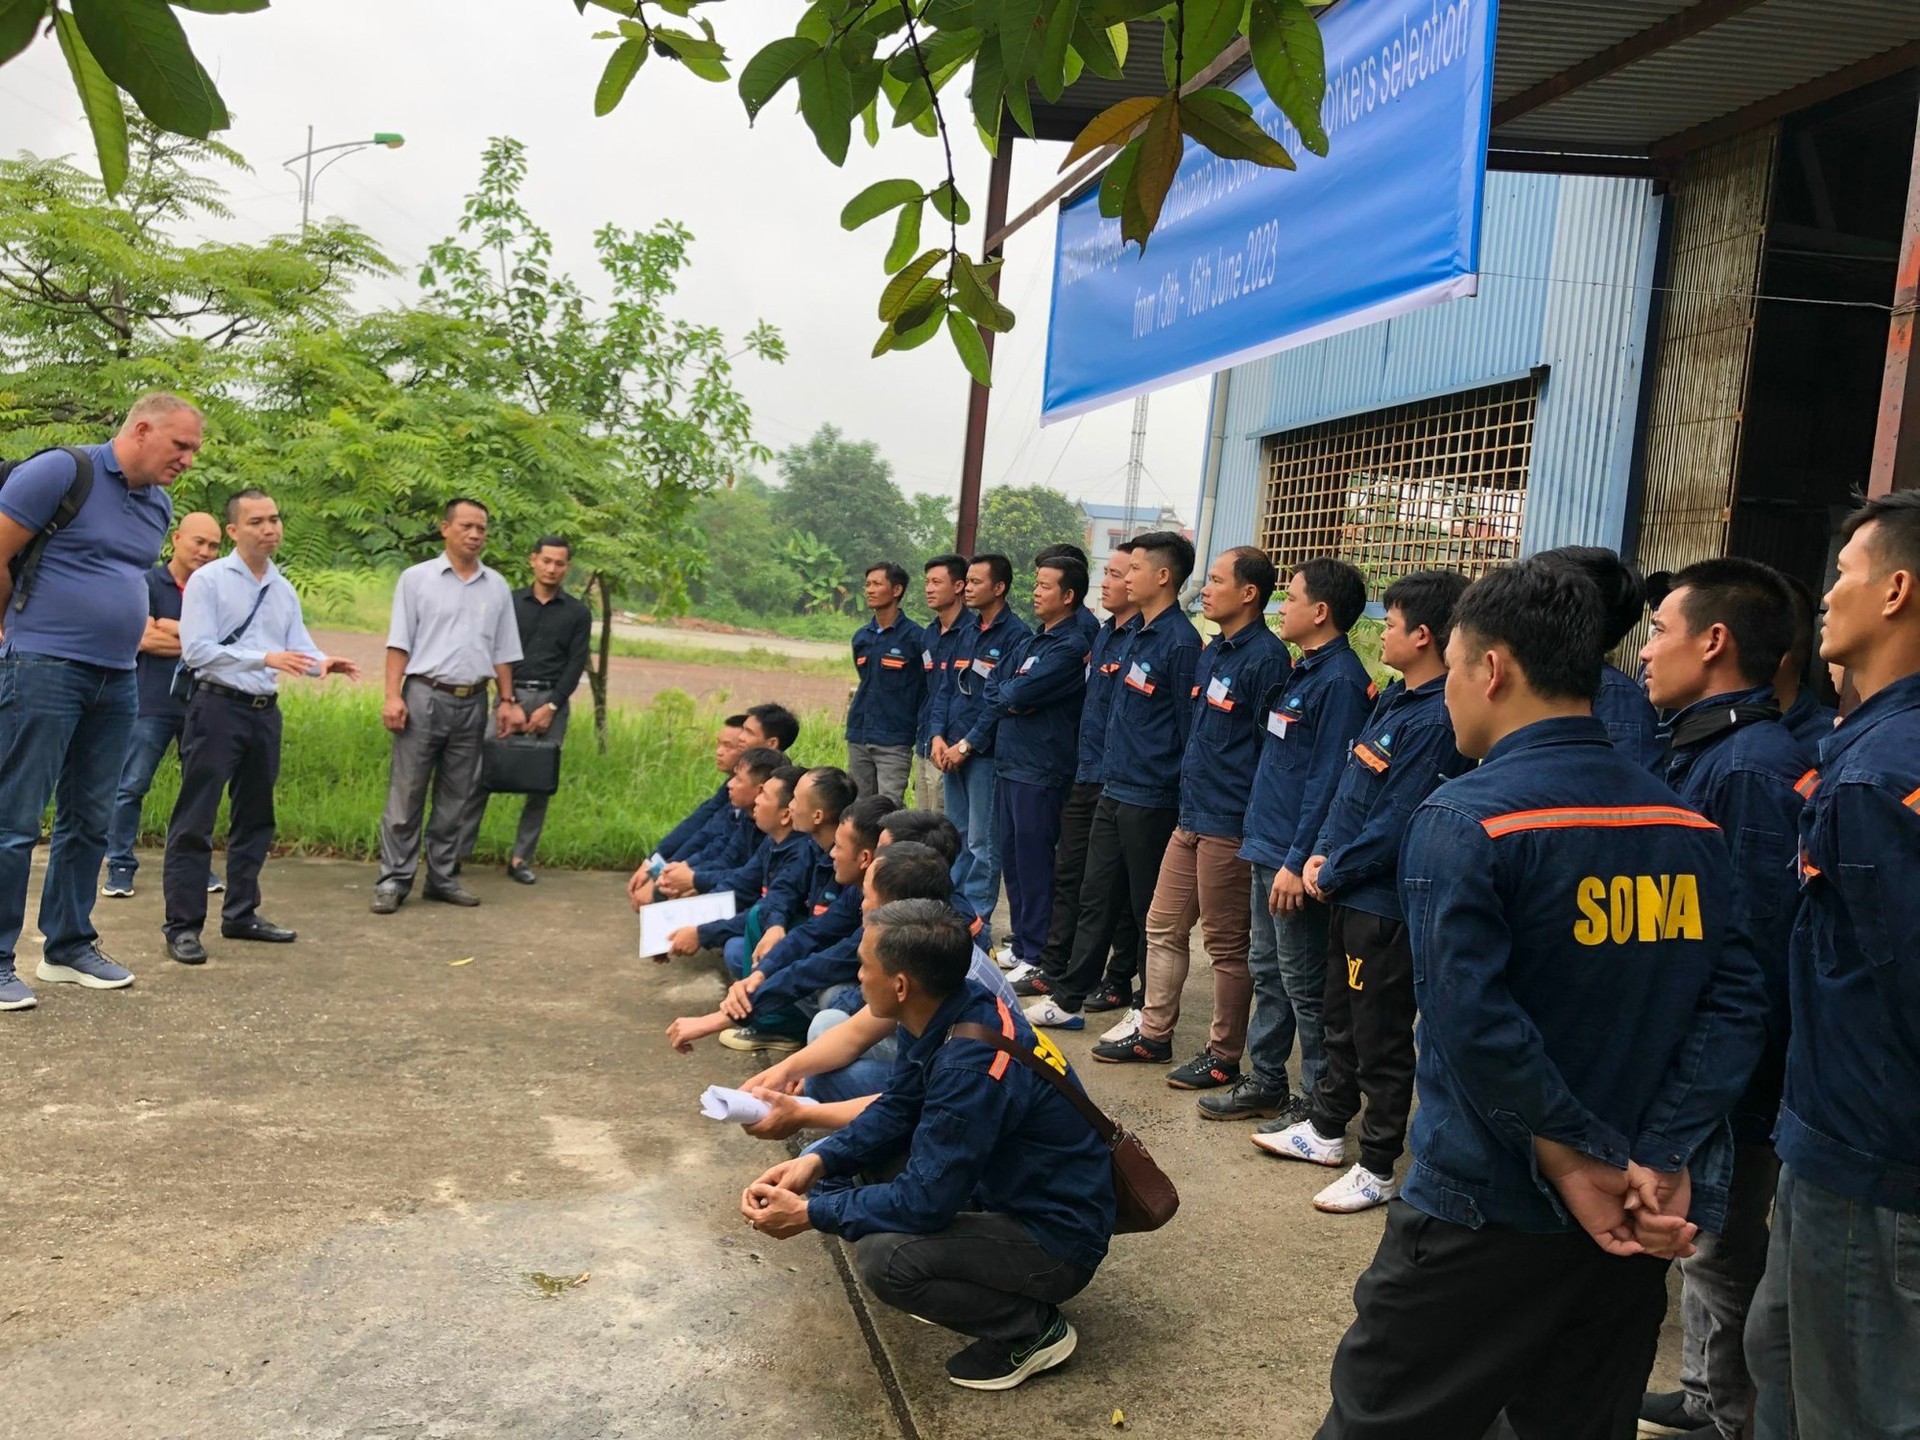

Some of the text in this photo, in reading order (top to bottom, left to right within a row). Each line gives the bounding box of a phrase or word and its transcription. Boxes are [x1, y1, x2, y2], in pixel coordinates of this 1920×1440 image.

[1320, 56, 1376, 137] orkers
[1380, 0, 1469, 104] selection
[1132, 286, 1155, 340] from
[1157, 269, 1179, 330] 13th
[1187, 252, 1211, 317] 16th
[1212, 246, 1242, 308] June
[1243, 218, 1278, 295] 2023
[1573, 873, 1703, 946] SONA
[1291, 1135, 1315, 1158] GRK
